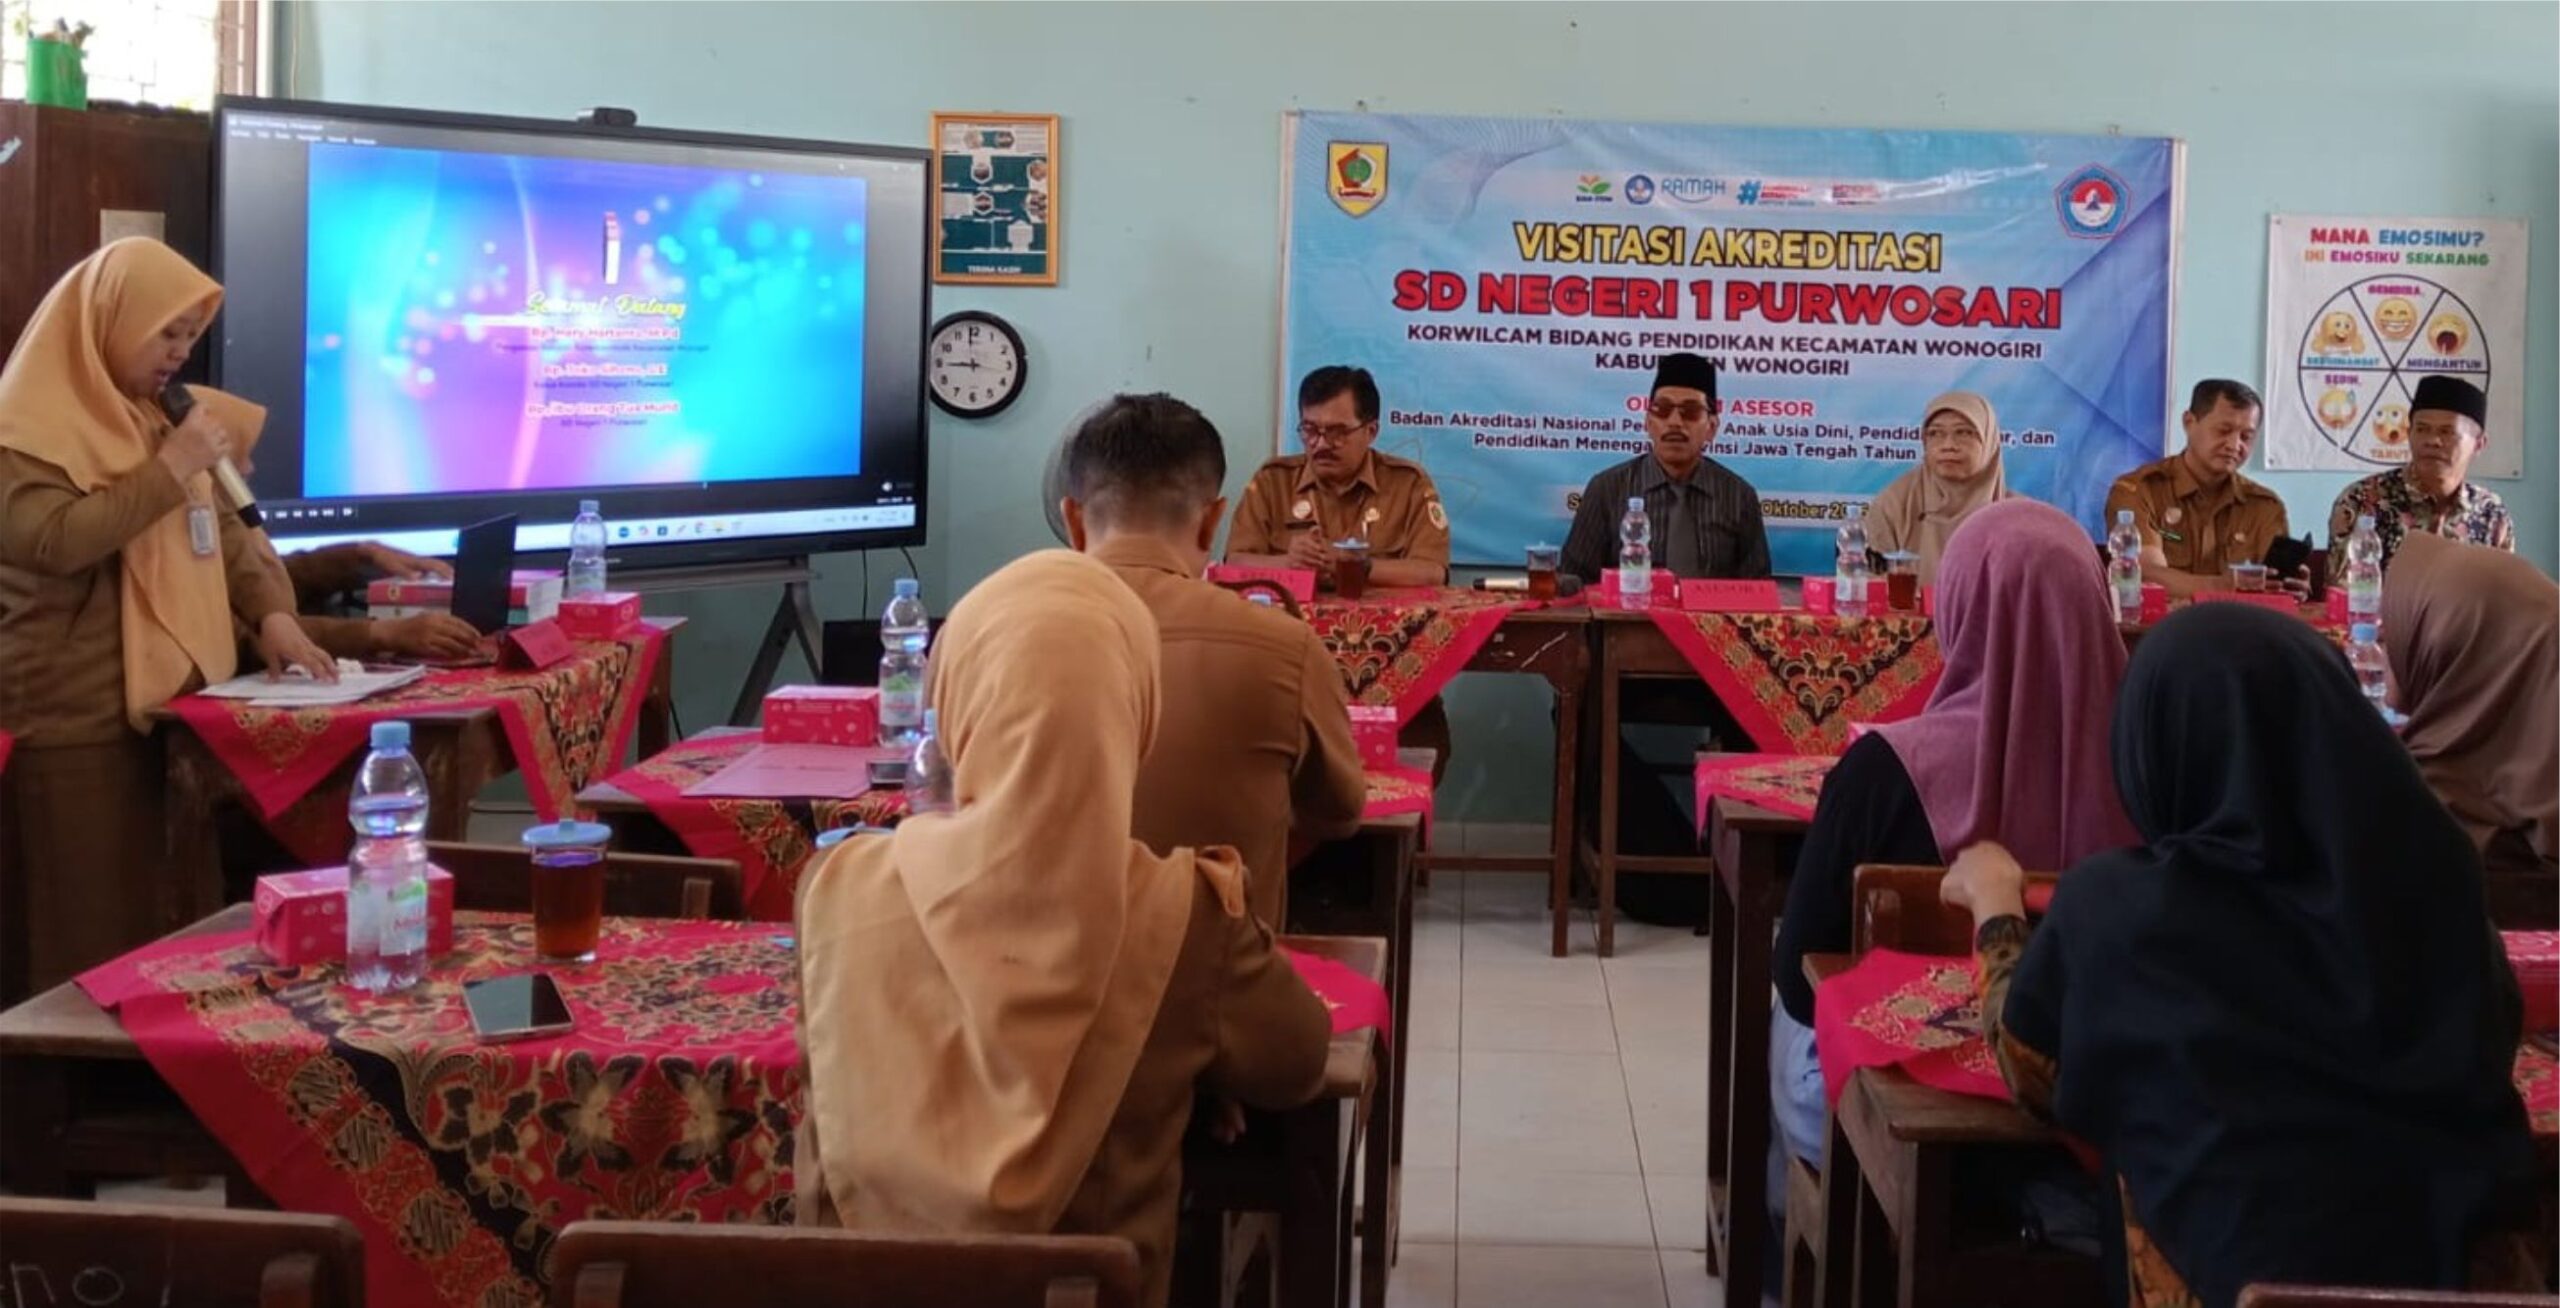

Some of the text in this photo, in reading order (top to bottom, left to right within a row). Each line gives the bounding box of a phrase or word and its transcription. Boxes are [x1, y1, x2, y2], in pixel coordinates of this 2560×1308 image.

[1661, 178, 1726, 194] RAMAH
[1513, 221, 1942, 272] VISITASI AKREDITASI
[2310, 229, 2485, 247] MANA EMOSIMU?
[2304, 250, 2490, 266] INI EMOSIKU SEKARANG
[1392, 269, 2062, 329] SD NEGERI 1 PURWOSARI
[1408, 324, 2042, 359] KORWILCAM BIDANG PENDIDIKAN KECAMATAN WONOGIRI
[1734, 357, 1849, 375] WONOGIRI
[1731, 400, 1813, 416] ASESOR
[1390, 411, 1443, 426] Badan
[1450, 413, 1537, 429] Akreditasi
[1542, 416, 1616, 432] Nasional
[1724, 422, 1767, 436] Anak
[1773, 424, 1809, 437] Usia
[1816, 425, 1854, 440] Dini,
[2022, 430, 2055, 445] dan
[1474, 433, 1569, 449] Pendidikan
[1744, 442, 1787, 455] Jawa
[1794, 443, 1857, 460] Tengah
[1864, 445, 1916, 460] Tahun
[1761, 499, 1827, 518] Oktober
